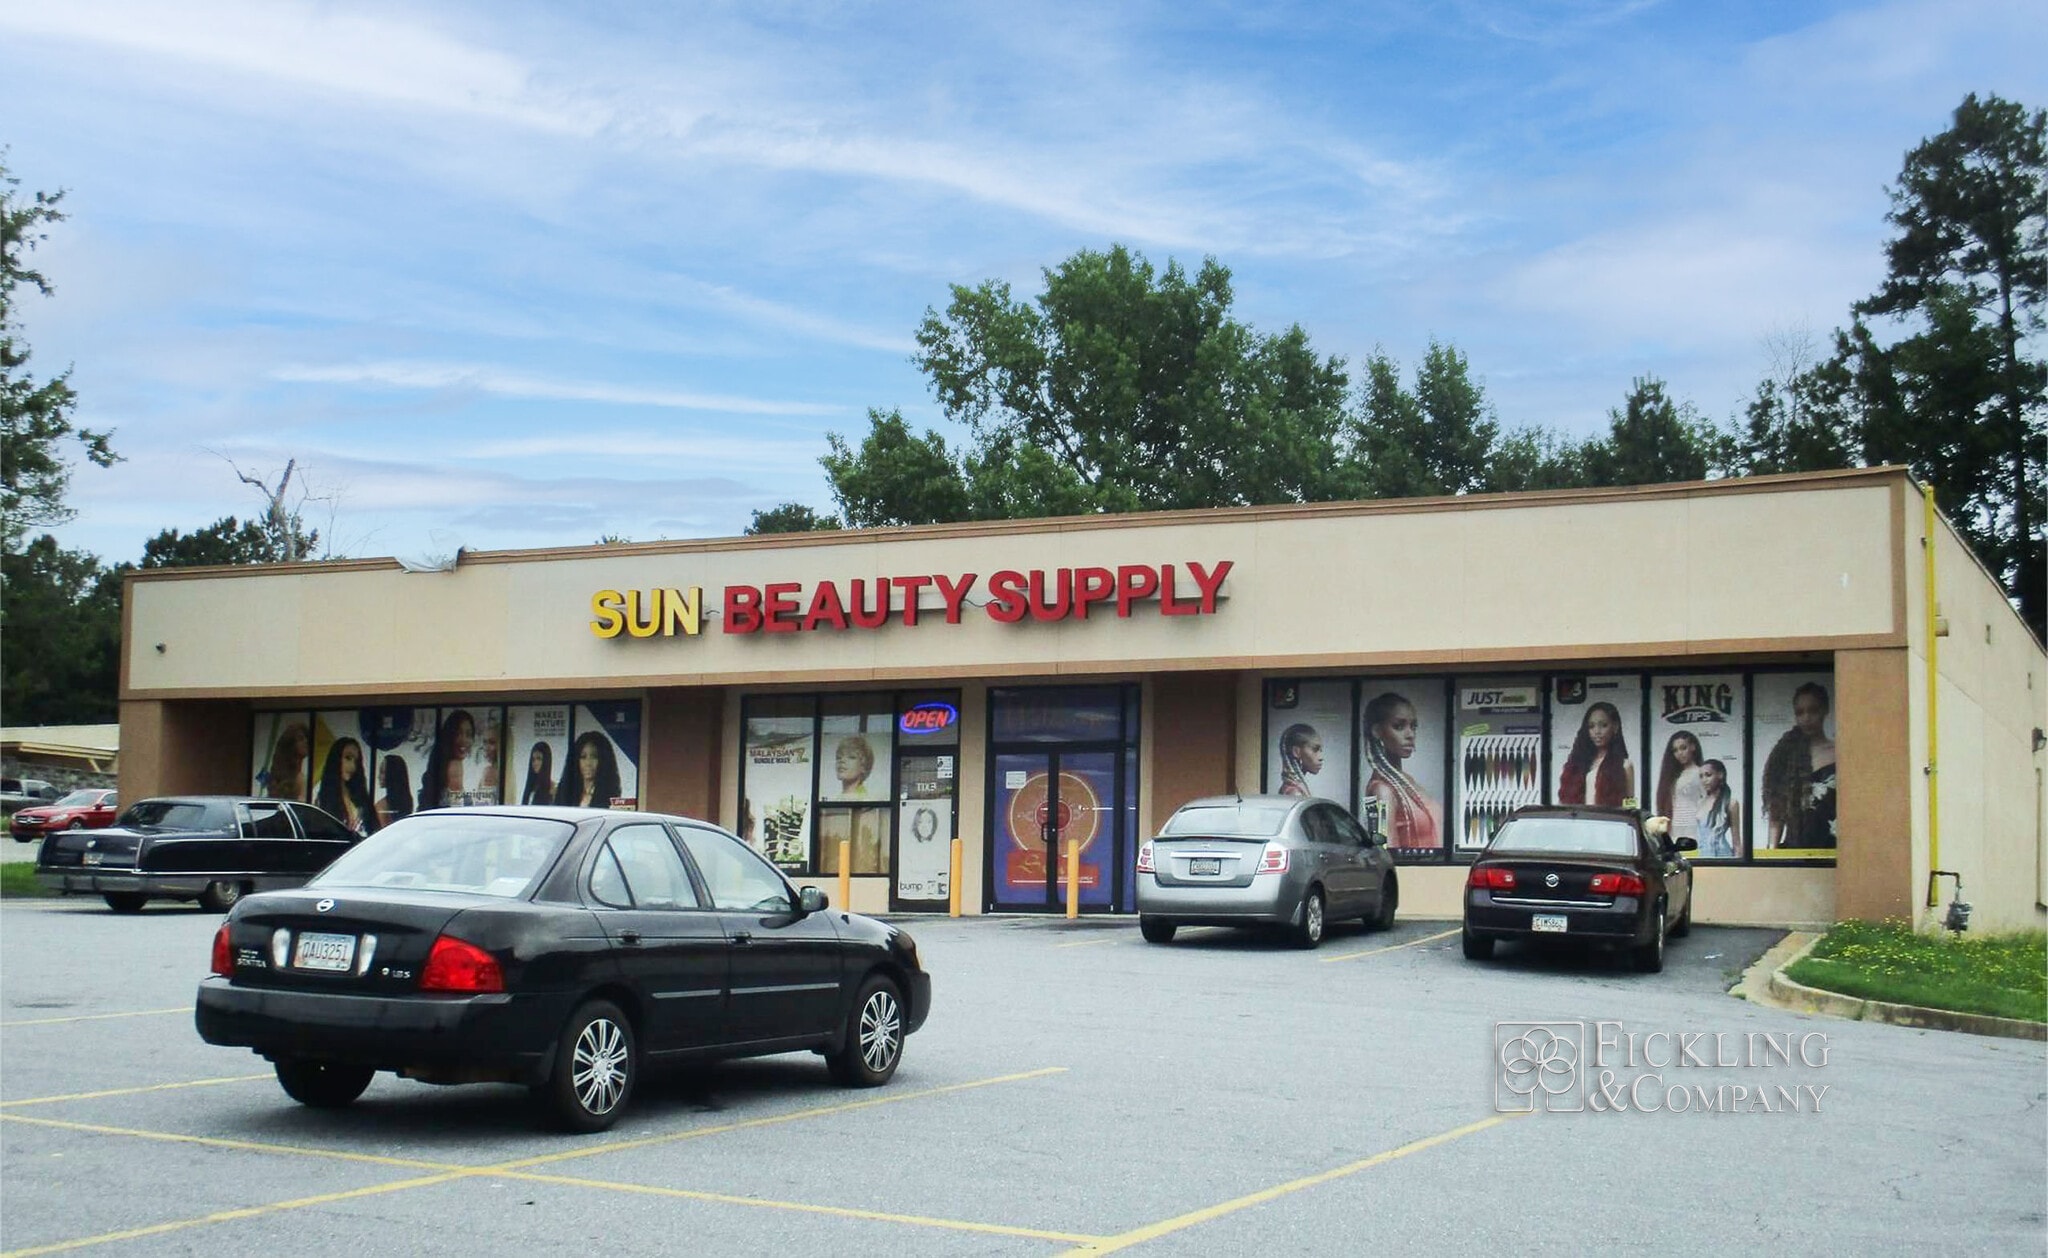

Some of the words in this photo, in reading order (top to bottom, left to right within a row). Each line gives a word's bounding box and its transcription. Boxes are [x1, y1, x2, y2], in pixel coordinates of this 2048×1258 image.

[590, 586, 702, 638] SUN
[723, 573, 977, 634] BEAUTY
[986, 561, 1234, 622] SUPPLY
[1468, 691, 1503, 705] JUST
[1661, 684, 1733, 718] KING
[534, 719, 566, 728] NATURE
[903, 710, 948, 728] OPEN
[1686, 711, 1711, 721] TIPS
